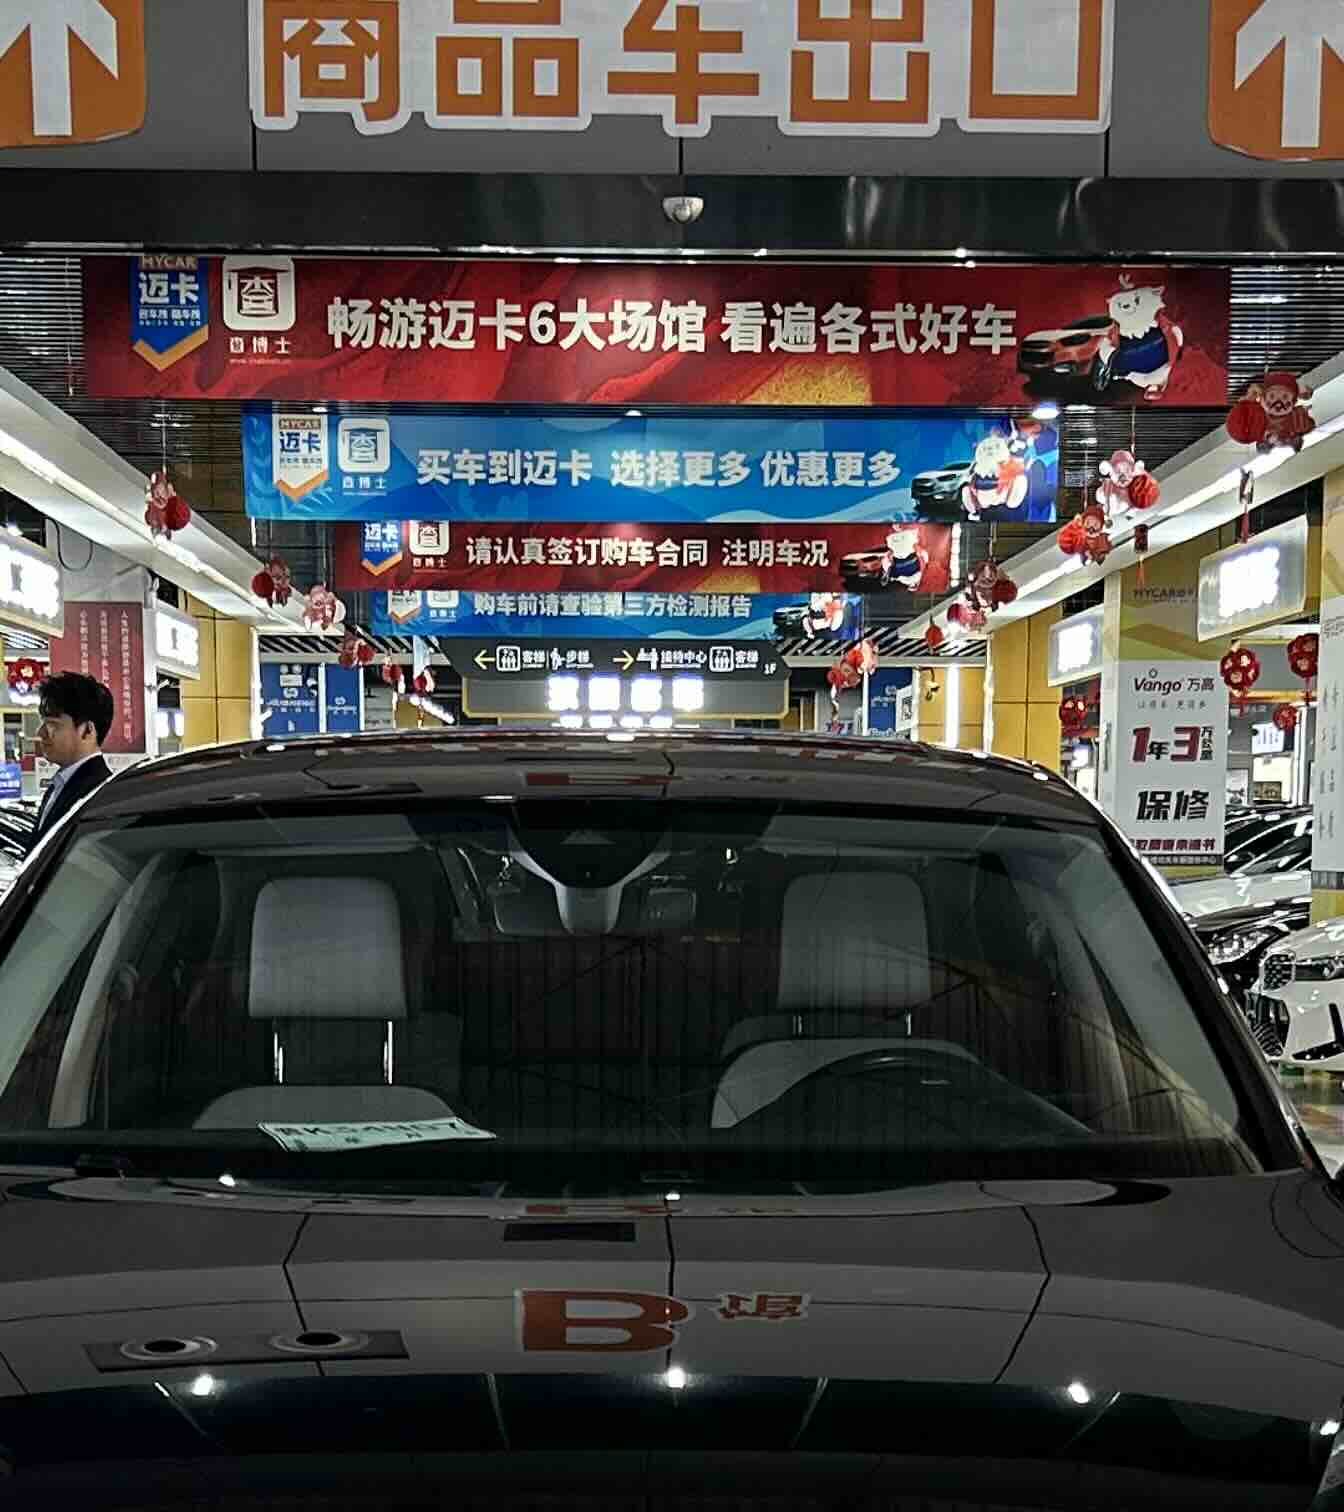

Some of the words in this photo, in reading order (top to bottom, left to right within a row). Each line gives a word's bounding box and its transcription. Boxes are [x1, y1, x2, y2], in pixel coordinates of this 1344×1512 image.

[138, 271, 200, 305] 迈卡
[327, 297, 707, 352] 畅游迈卡6大场馆
[721, 300, 1017, 354] 看遍各式好车
[279, 431, 322, 454] 迈卡
[416, 447, 593, 487] 买车到迈卡
[610, 447, 751, 487] 选择更多
[760, 447, 901, 487] 优惠更多
[465, 536, 710, 567] 请认真签订购车合同
[721, 536, 830, 568] 注明车况
[473, 592, 753, 618] 购车前请查验第三方检测报告
[1134, 677, 1183, 696] Vango
[1187, 677, 1216, 692] 万高
[1136, 789, 1210, 822] 保修
